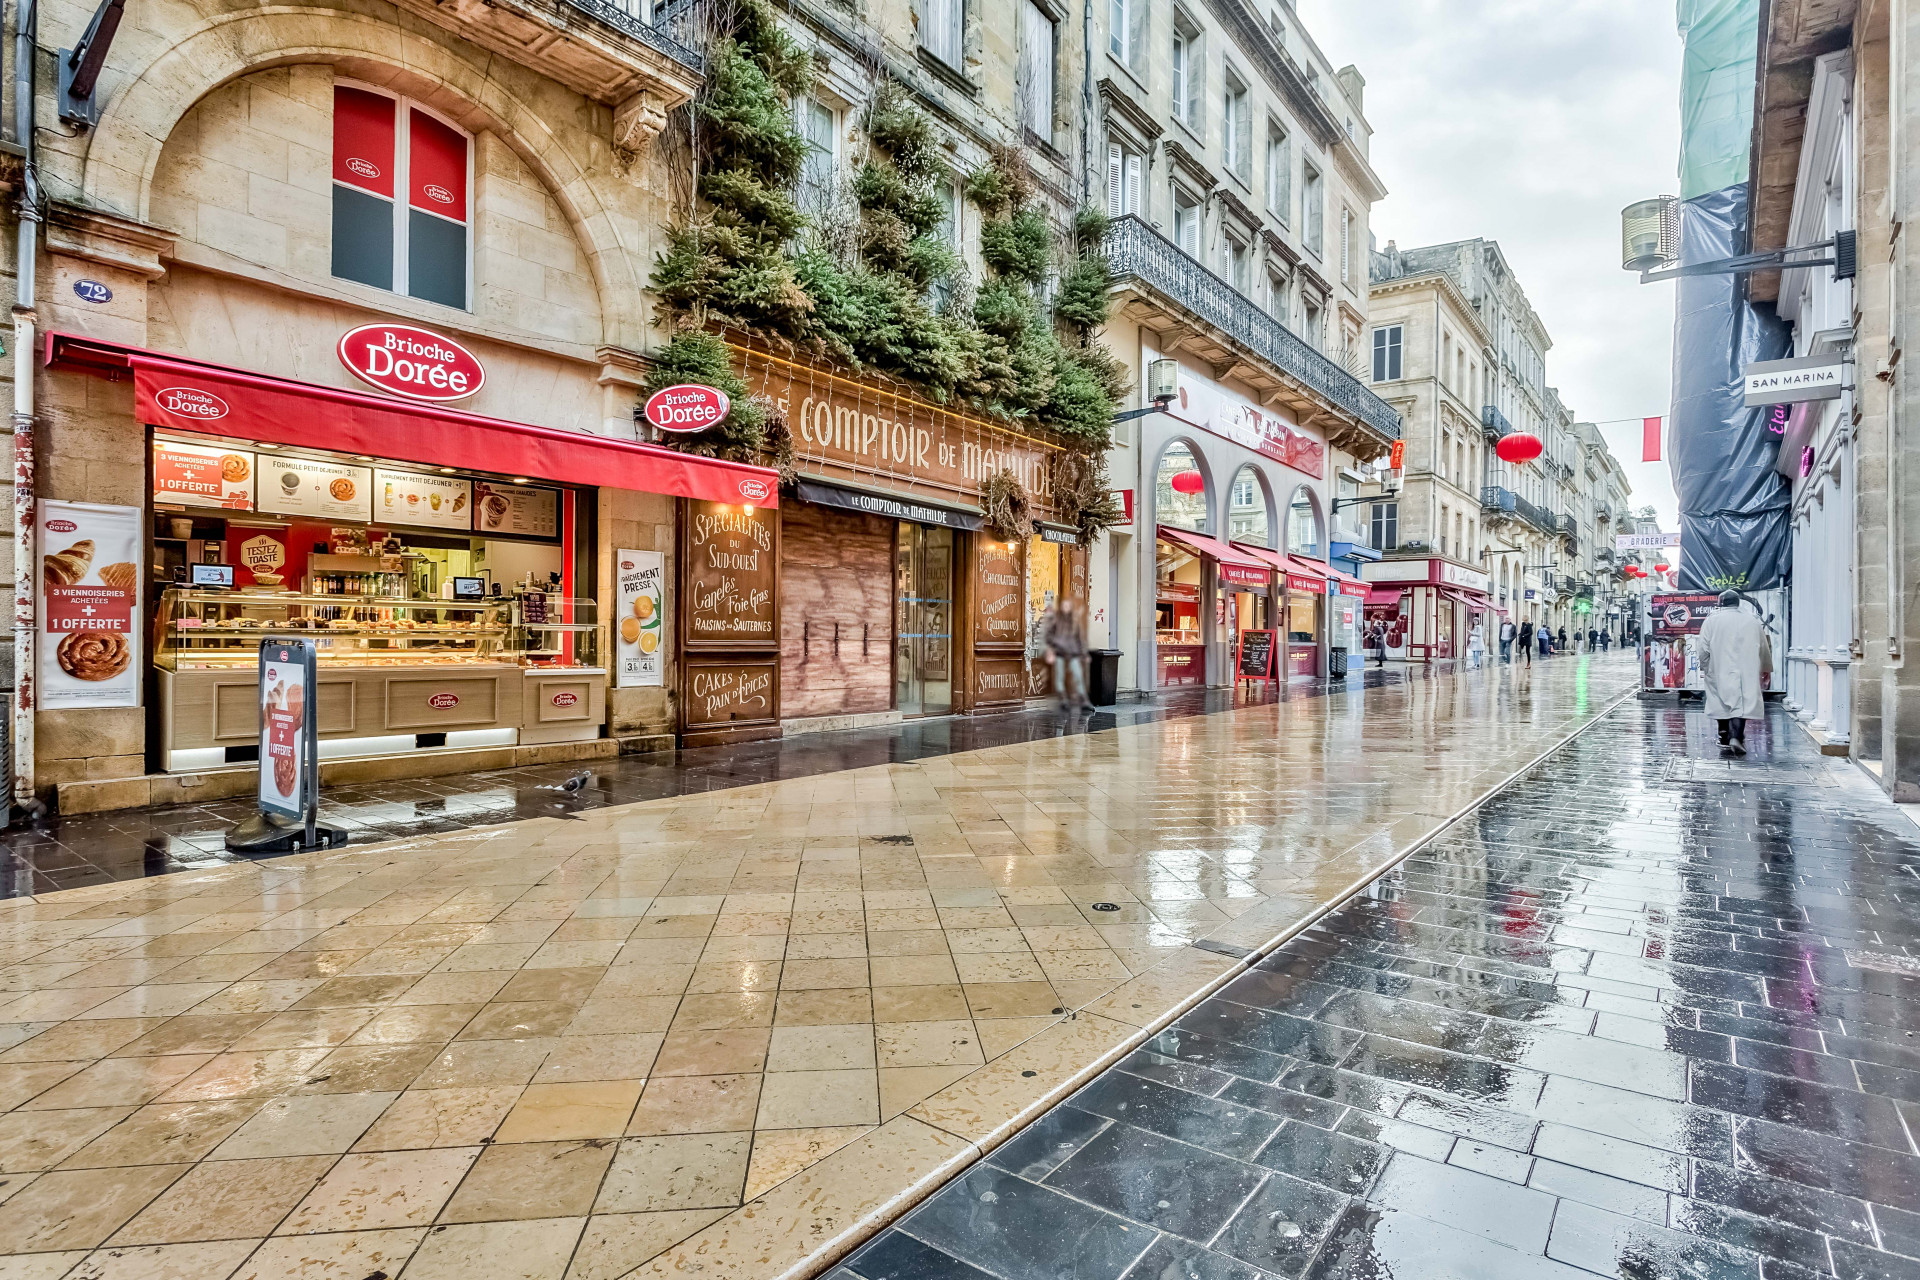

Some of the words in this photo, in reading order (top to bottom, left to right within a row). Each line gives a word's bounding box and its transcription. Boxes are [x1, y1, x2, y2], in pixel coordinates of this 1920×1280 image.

[351, 163, 376, 177] Dorée
[428, 189, 451, 202] Dorée
[81, 282, 107, 300] 72
[384, 332, 455, 363] Brioche
[366, 344, 468, 392] Dorée
[1752, 378, 1778, 388] SAN
[1783, 371, 1834, 385] MARINA
[176, 391, 213, 404] Brioche
[665, 392, 706, 405] Brioche
[167, 396, 220, 417] Dorée
[657, 405, 717, 424] Dorée
[800, 396, 930, 469] COMPTOIR
[939, 443, 956, 468] DE
[167, 454, 219, 466] VIENNOISERIES
[174, 462, 205, 471] ACHETÉES
[273, 461, 302, 470] FORMULE
[160, 479, 165, 488] 1
[743, 486, 765, 497] Dorée
[851, 496, 859, 505] LE
[860, 495, 901, 514] COMPTOIR
[911, 506, 947, 523] MATHILDE
[729, 540, 740, 549] DU
[1630, 537, 1667, 546] BRADERIE
[246, 545, 278, 556] TESTEZ
[983, 569, 1019, 586] CHOCOLATERIE
[62, 589, 125, 597] VIENNOISERIES
[694, 576, 736, 614] Canelés
[70, 597, 109, 605] ACHETÉES
[728, 594, 749, 615] Foie
[750, 588, 769, 614] Gras
[981, 594, 1017, 615] CONFISERIES
[52, 619, 58, 629] 1
[694, 618, 726, 631] RAISINS
[733, 618, 771, 632] SAUTERNES
[693, 673, 733, 698] CAKES
[979, 671, 1019, 694] SPIRITUEUX
[433, 699, 457, 707] Dorée
[706, 691, 730, 718] PAIN
